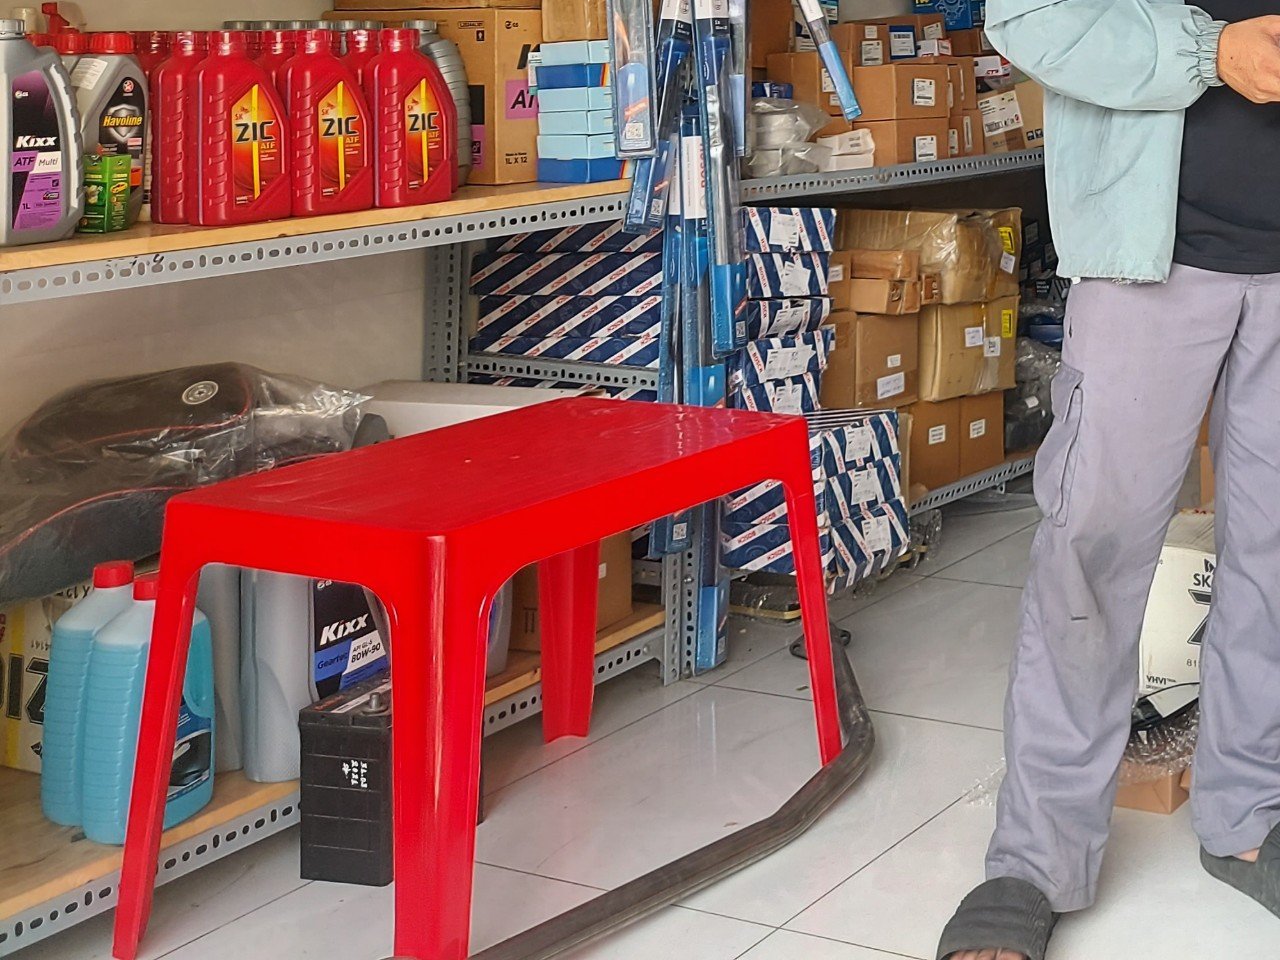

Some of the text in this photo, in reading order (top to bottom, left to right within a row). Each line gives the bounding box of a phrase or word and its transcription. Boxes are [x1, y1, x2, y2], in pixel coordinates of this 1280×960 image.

[510, 89, 539, 110] AT
[103, 115, 143, 127] Havoline
[322, 115, 360, 136] ZIC
[408, 111, 439, 132] ZIC
[235, 120, 276, 143] ZIC
[16, 135, 58, 148] Kixx
[345, 136, 360, 144] ATF
[14, 156, 35, 167] ATF
[38, 158, 58, 167] Multi
[22, 202, 31, 210] 1L
[1193, 573, 1212, 588] SK
[319, 613, 369, 646] Kixx
[351, 643, 380, 662] 80W-90
[317, 652, 349, 669] Geartec
[1146, 675, 1167, 686] VHVI
